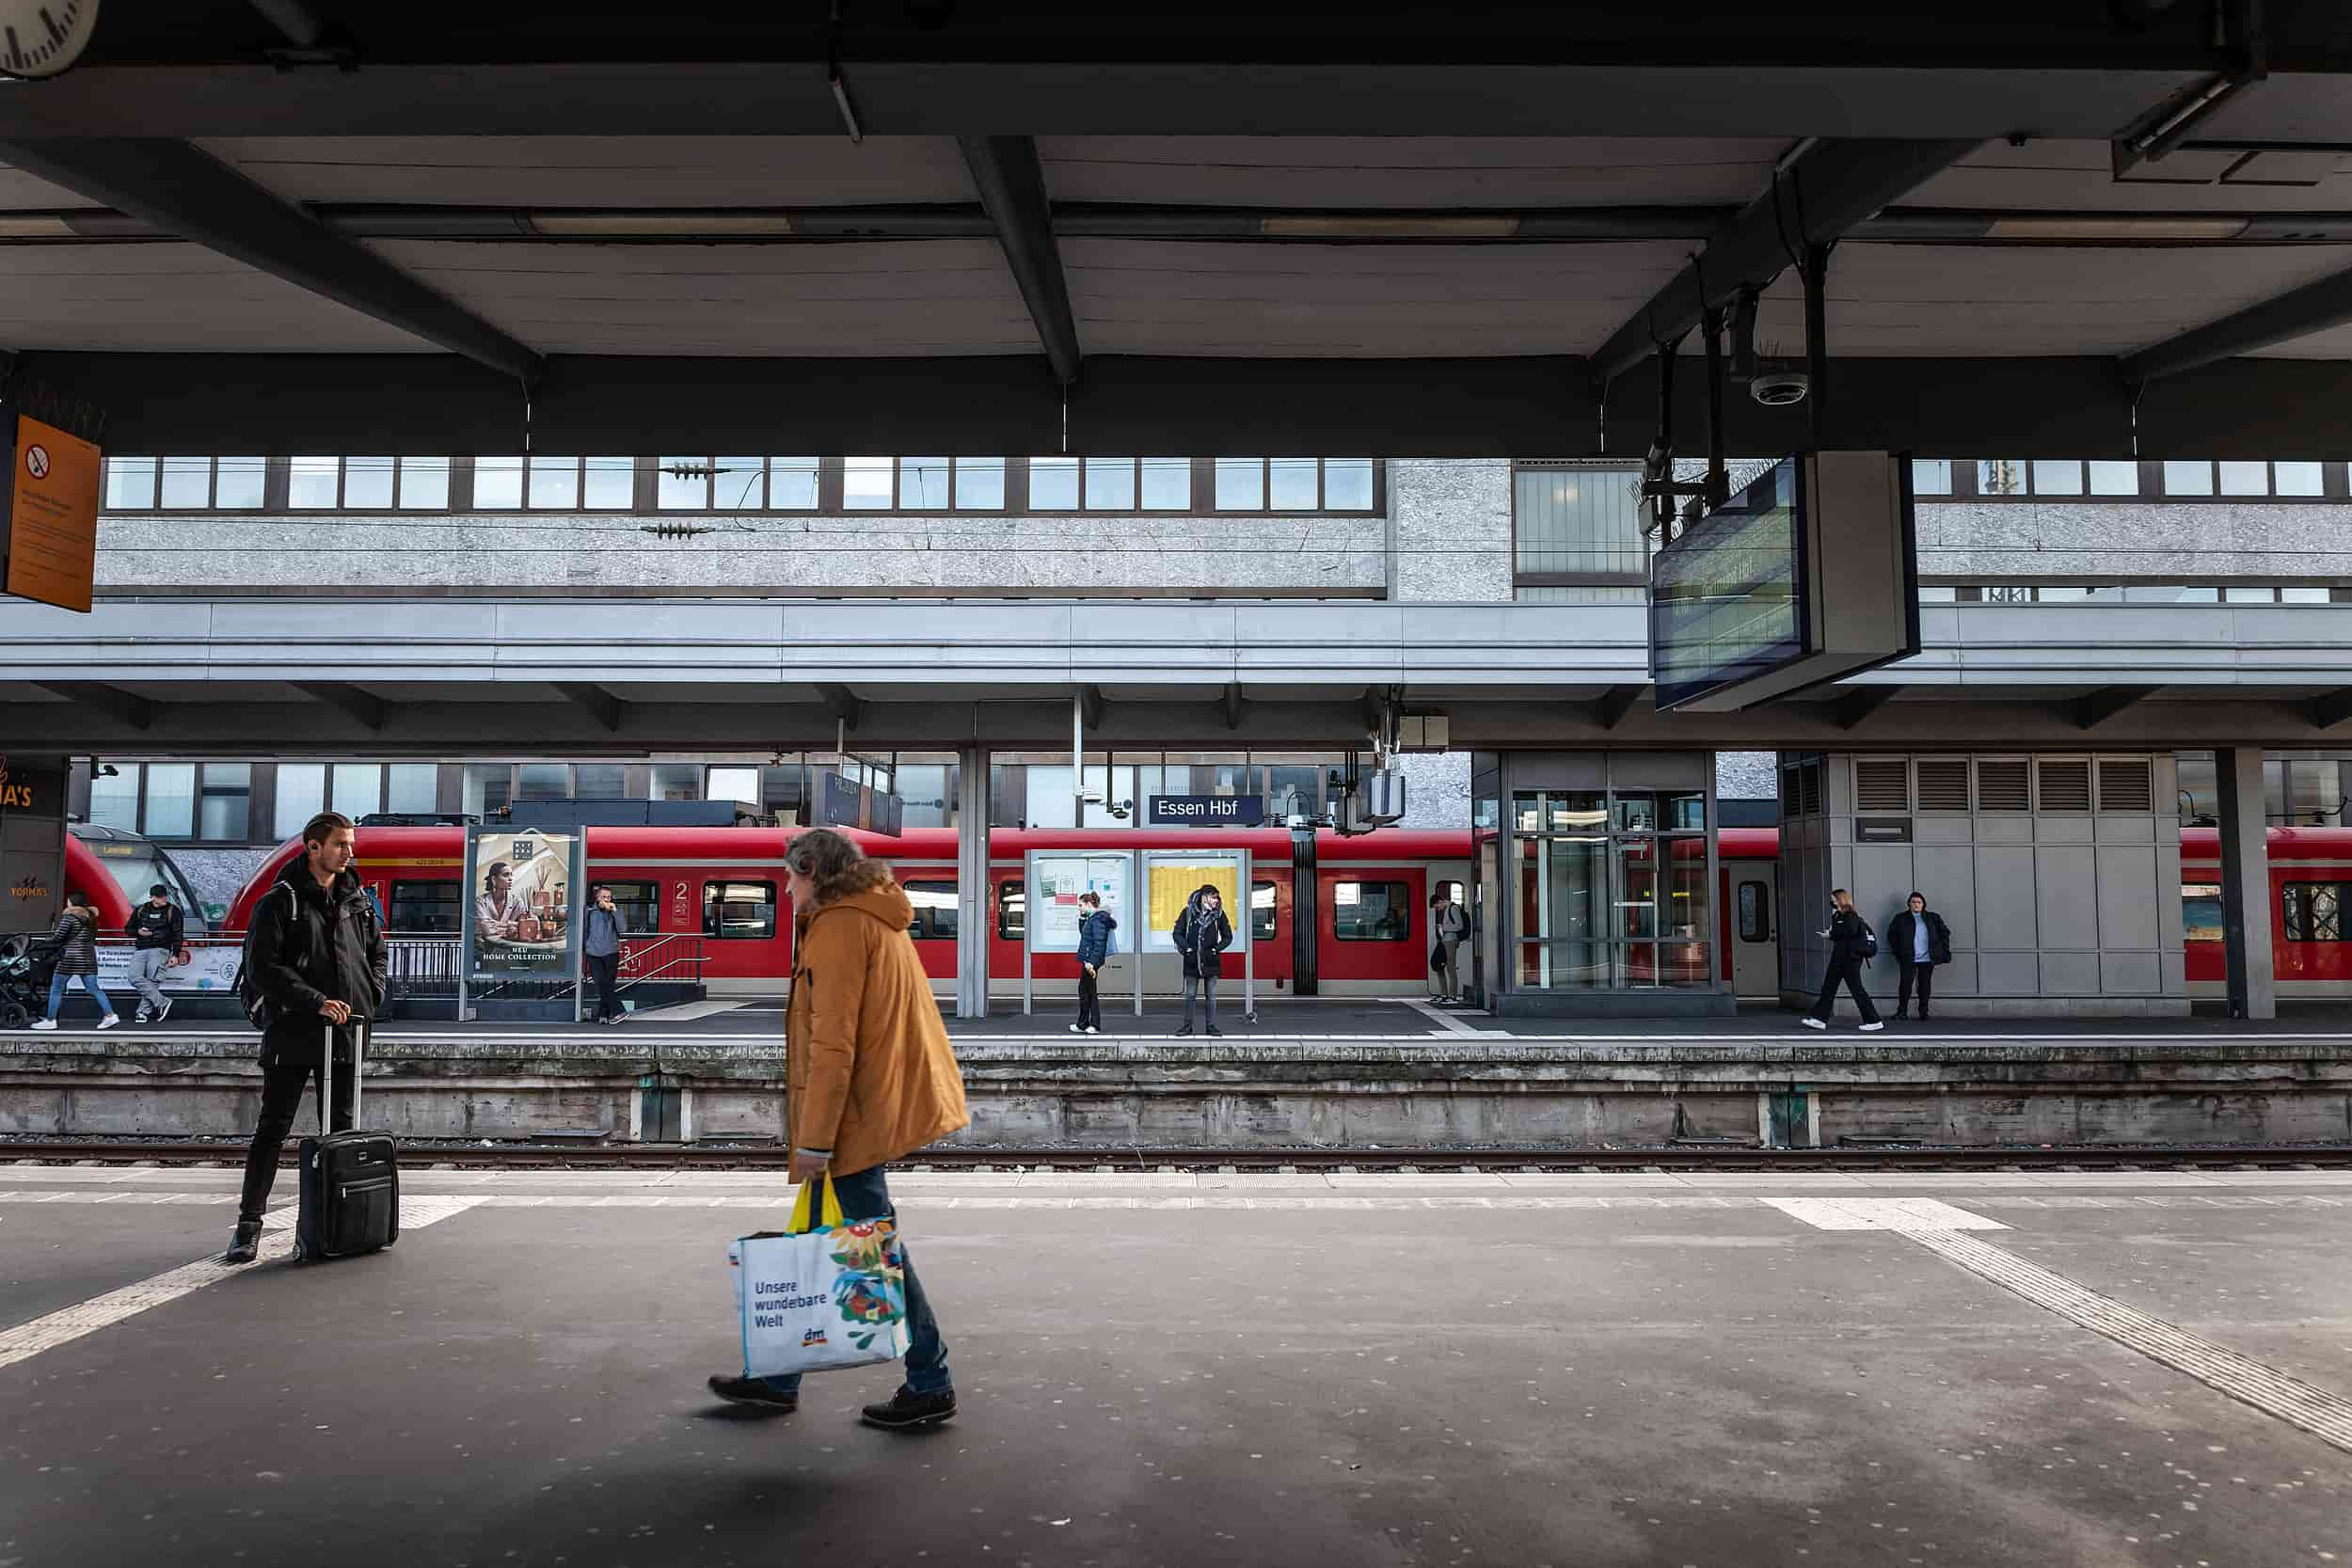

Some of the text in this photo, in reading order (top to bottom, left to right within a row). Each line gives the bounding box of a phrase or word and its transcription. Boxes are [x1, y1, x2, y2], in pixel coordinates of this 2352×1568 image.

[1158, 800, 1238, 816] Essen Hbf
[675, 882, 688, 899] 2
[755, 1280, 798, 1294] Unsere
[755, 1293, 827, 1310] wunderbare
[755, 1315, 784, 1328] Welt
[804, 1327, 825, 1340] dm
